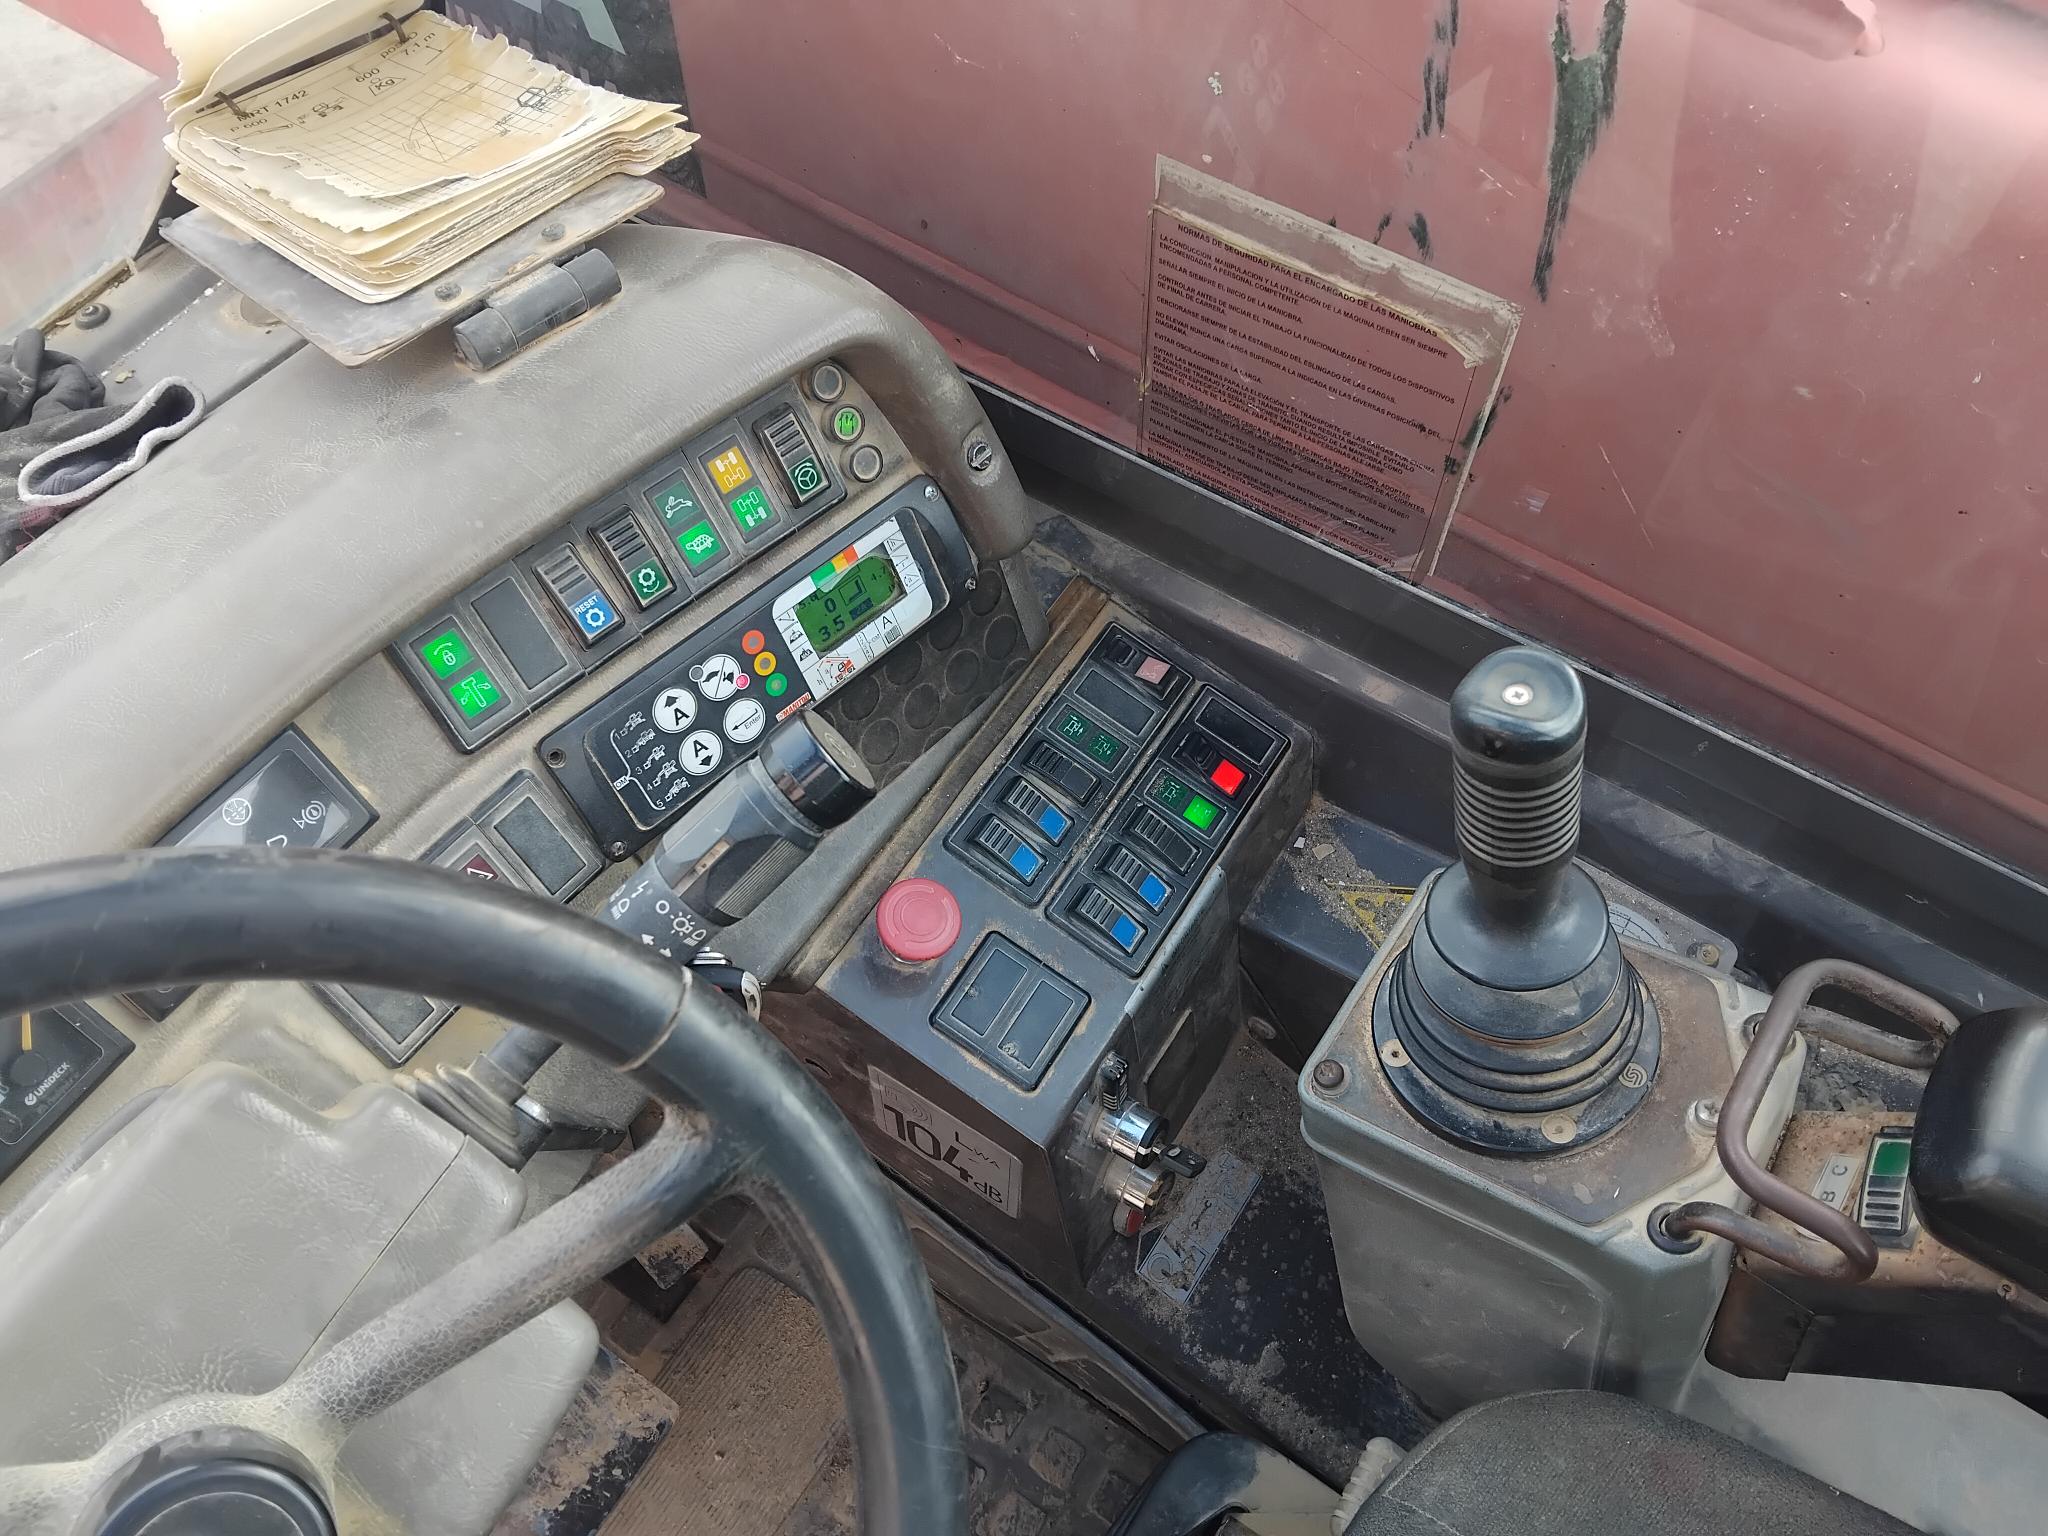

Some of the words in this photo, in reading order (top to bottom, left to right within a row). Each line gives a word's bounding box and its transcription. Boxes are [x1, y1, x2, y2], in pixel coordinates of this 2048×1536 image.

[355, 67, 380, 83] 600
[273, 89, 308, 107] 1742
[1159, 233, 1168, 243] LA
[1269, 279, 1279, 289] LA
[1321, 300, 1332, 311] DE
[1332, 305, 1343, 315] LA
[1177, 223, 1210, 244] NORMAS
[1211, 237, 1222, 249] DE
[1223, 242, 1269, 268] SEGURIDAD
[1270, 261, 1292, 278] PARA
[1292, 271, 1304, 283] EL
[1304, 276, 1356, 304] ENCARGADO
[1356, 297, 1369, 309] DE
[1369, 303, 1387, 317] LAS
[1387, 310, 1438, 338] MANIOBRAS
[1157, 280, 1166, 290] DE
[1185, 292, 1194, 302] DE
[1217, 281, 1224, 291] EL
[1246, 294, 1256, 304] DE
[1257, 298, 1266, 308] LA
[1218, 298, 1227, 308] DE
[1252, 313, 1260, 322] EL
[1292, 330, 1302, 340] LA
[1356, 357, 1367, 367] DE
[1238, 330, 1247, 340] LA
[574, 594, 599, 615] RESET
[881, 614, 893, 630] A
[672, 706, 690, 726] A
[782, 693, 811, 719] MANITOU
[743, 713, 762, 731] Enter
[624, 749, 632, 759] 2
[692, 738, 710, 758] A
[635, 765, 644, 776] 3
[655, 799, 665, 809] 5
[883, 1103, 974, 1183] 104
[973, 1181, 1003, 1204] dB
[1821, 1190, 1837, 1203] B
[1831, 1163, 1849, 1177] C
